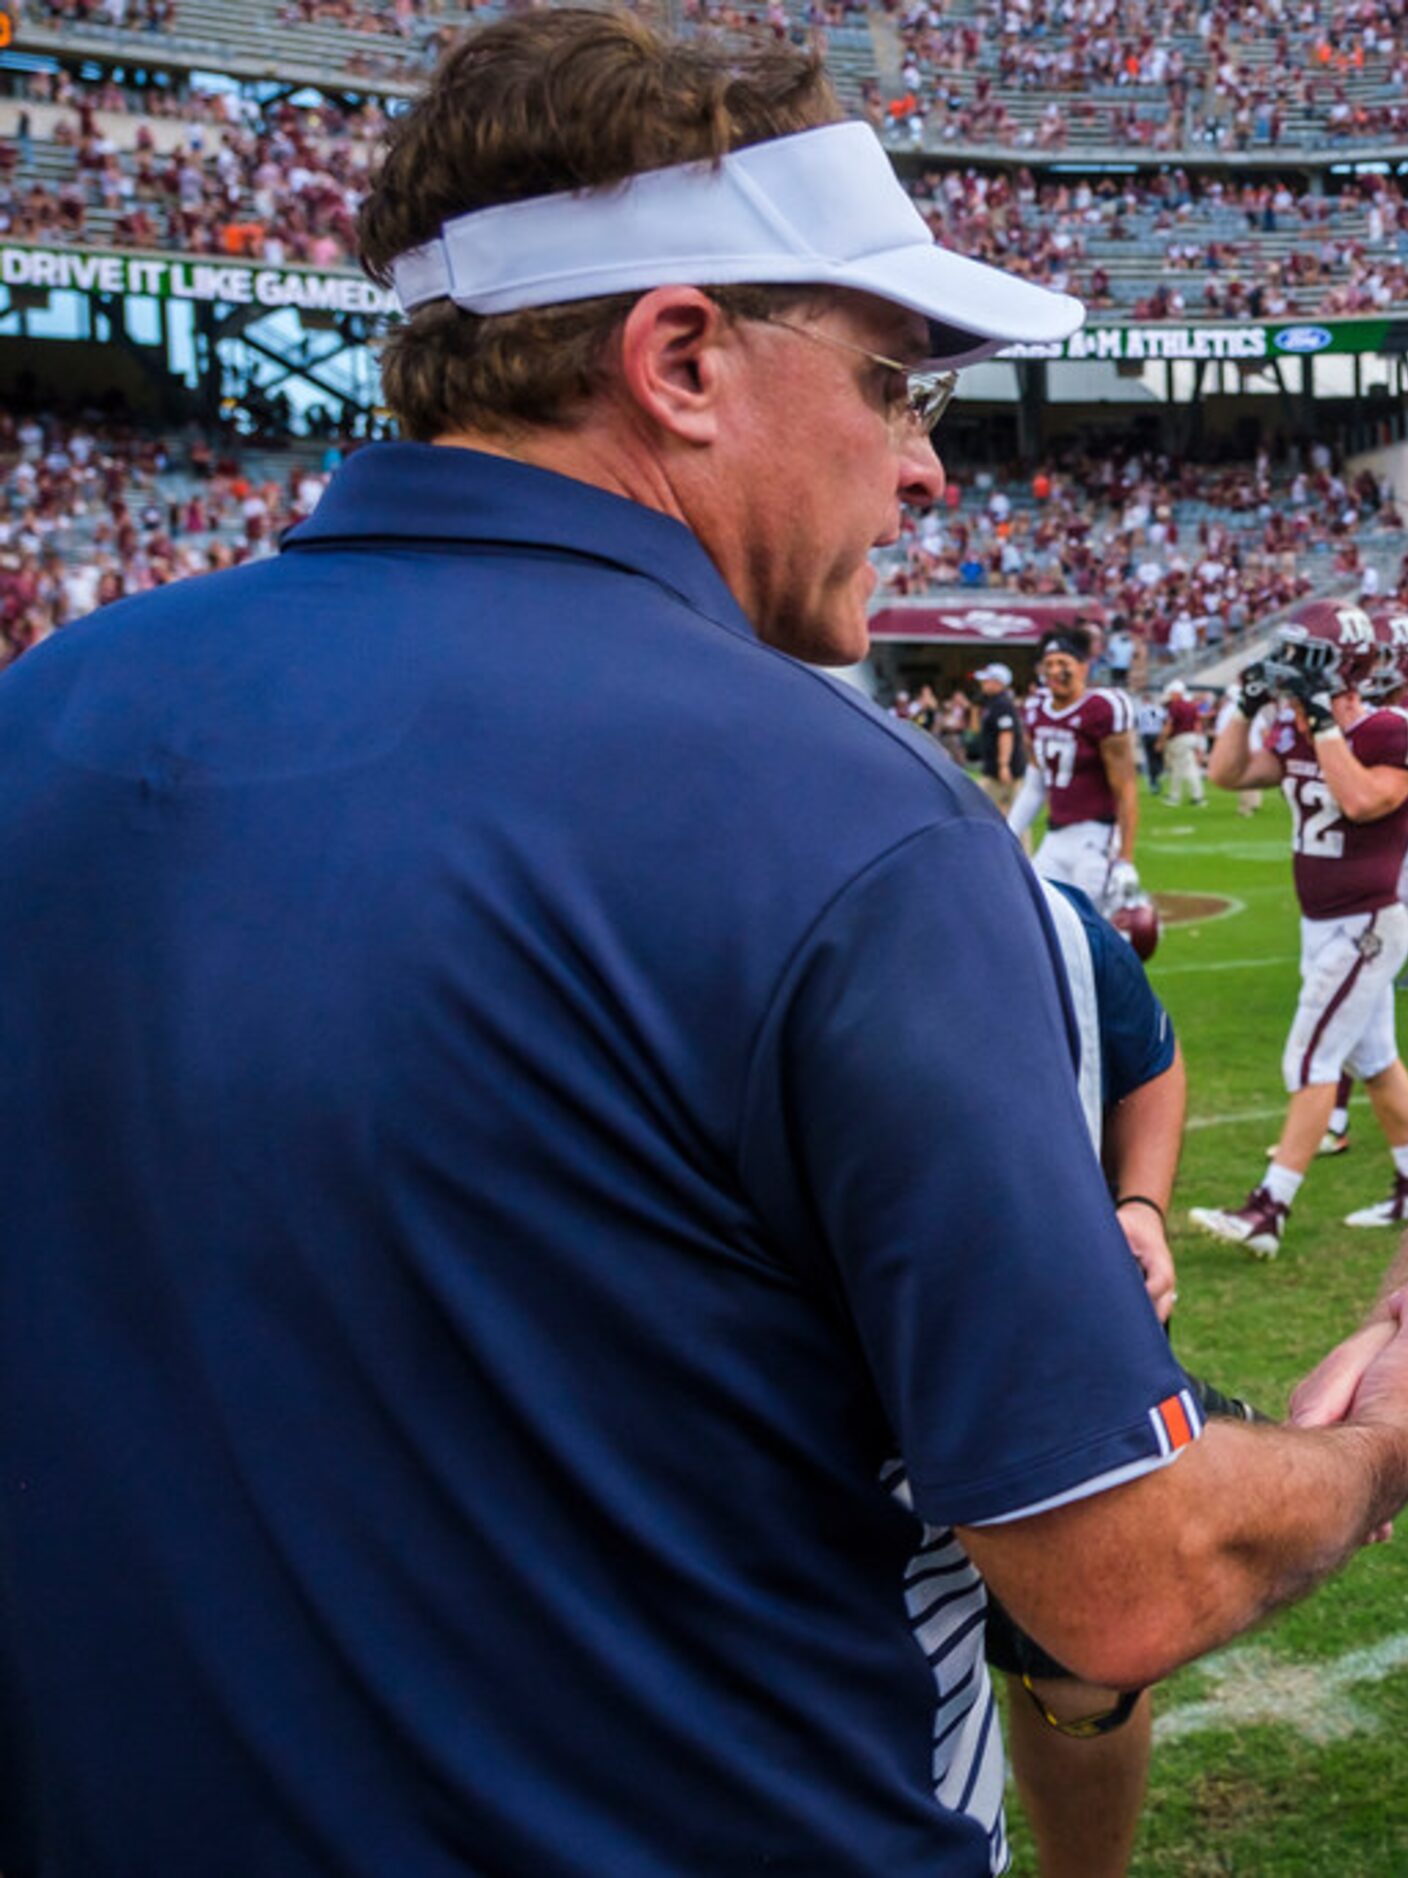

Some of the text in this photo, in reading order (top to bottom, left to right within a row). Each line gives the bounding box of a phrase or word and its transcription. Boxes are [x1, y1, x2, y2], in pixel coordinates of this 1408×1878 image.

[2, 249, 125, 292] DRIVE
[128, 258, 169, 296] IT
[170, 264, 254, 303] LIKE
[1126, 328, 1267, 358] ATHLETICS
[1033, 737, 1076, 789] 17
[1282, 775, 1345, 859] 12
